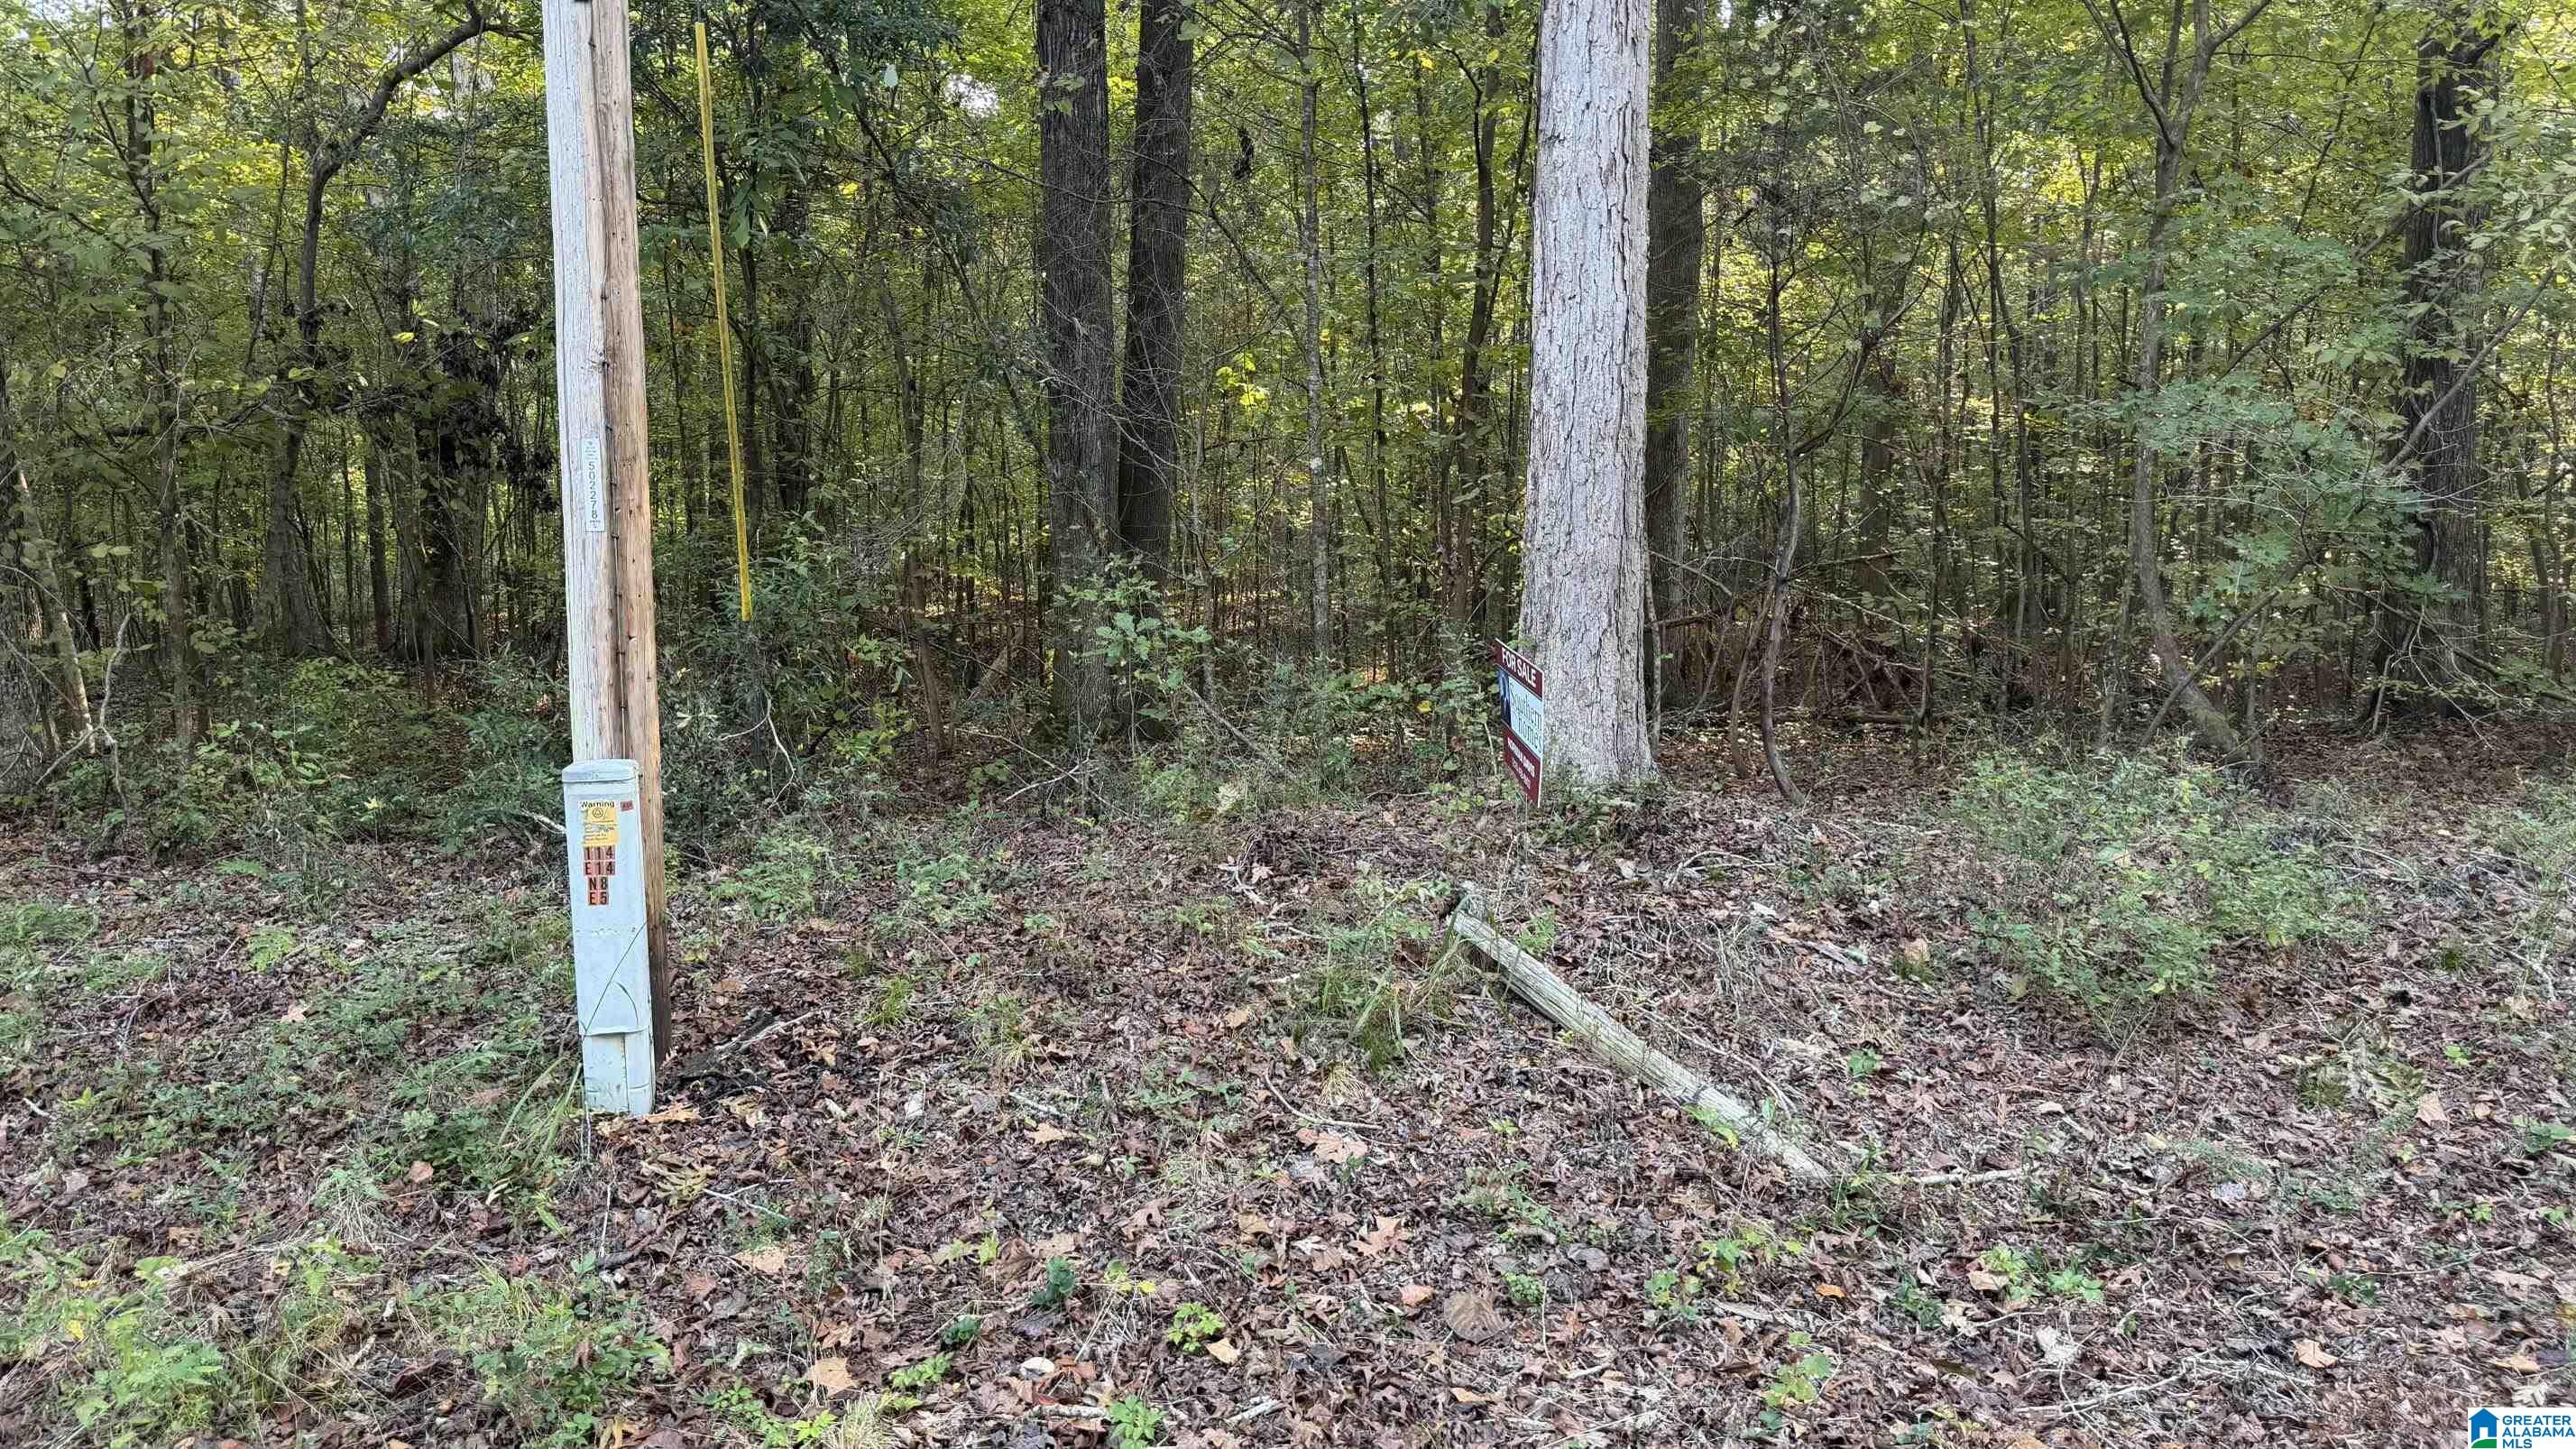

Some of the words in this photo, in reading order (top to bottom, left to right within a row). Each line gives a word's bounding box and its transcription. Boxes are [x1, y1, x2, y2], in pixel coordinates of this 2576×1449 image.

[588, 461, 598, 520] 502278
[1501, 647, 1517, 673] FOR
[1517, 660, 1537, 688] SALE
[1509, 683, 1542, 731] Southern
[581, 800, 615, 808] Warning
[584, 861, 614, 875] E14
[589, 876, 607, 891] N8
[589, 891, 607, 905] E5
